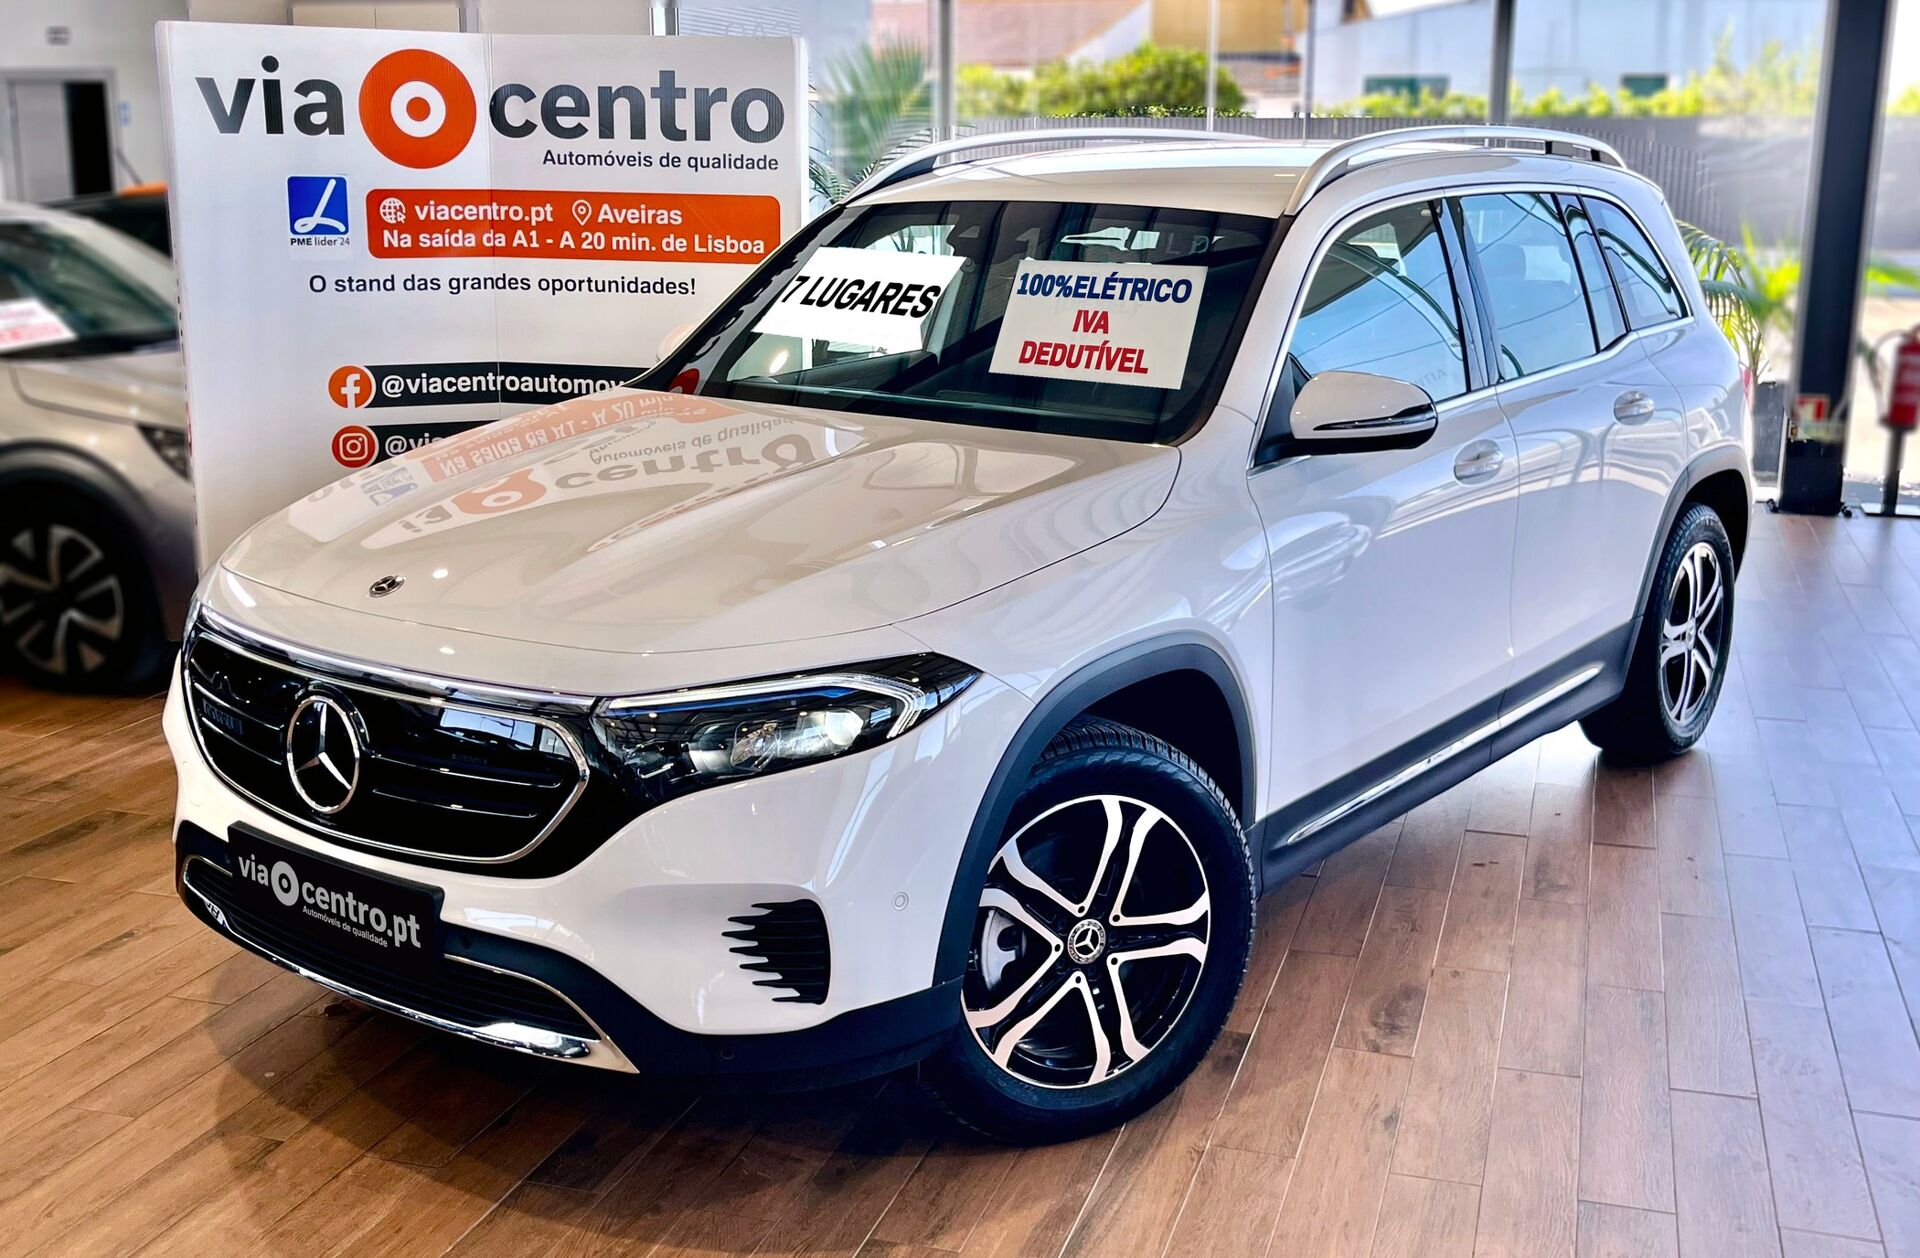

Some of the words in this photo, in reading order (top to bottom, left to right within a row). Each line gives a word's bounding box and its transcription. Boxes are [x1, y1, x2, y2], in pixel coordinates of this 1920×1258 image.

[195, 55, 345, 135] via
[490, 69, 785, 142] centro
[543, 149, 653, 168] Automóveis
[659, 152, 682, 168] de
[687, 153, 779, 172] qualidade
[415, 200, 553, 226] viacentro.pt
[598, 204, 683, 225] Aveiras
[290, 237, 312, 246] PME
[314, 237, 337, 246] líder
[383, 230, 411, 248] Na
[418, 229, 475, 248] saída
[482, 230, 506, 248] da
[512, 229, 539, 248] A1
[559, 231, 575, 248] A
[581, 232, 605, 250] 20
[612, 233, 656, 251] min.
[661, 234, 688, 252] de
[694, 234, 765, 254] Lisboa
[309, 275, 326, 293] O
[334, 274, 395, 292] stand
[403, 274, 441, 291] das
[449, 273, 531, 294] grandes
[538, 276, 696, 295] oportunidades!
[782, 275, 805, 303] 7
[801, 277, 942, 319] LUGARES
[1072, 309, 1110, 334] IVA
[1018, 338, 1149, 375] DEDUTÍVEL
[238, 854, 269, 886] via
[302, 881, 421, 948] centro.pt
[303, 904, 341, 928] Automóveis
[342, 920, 351, 932] de
[352, 925, 388, 948] qualidade
